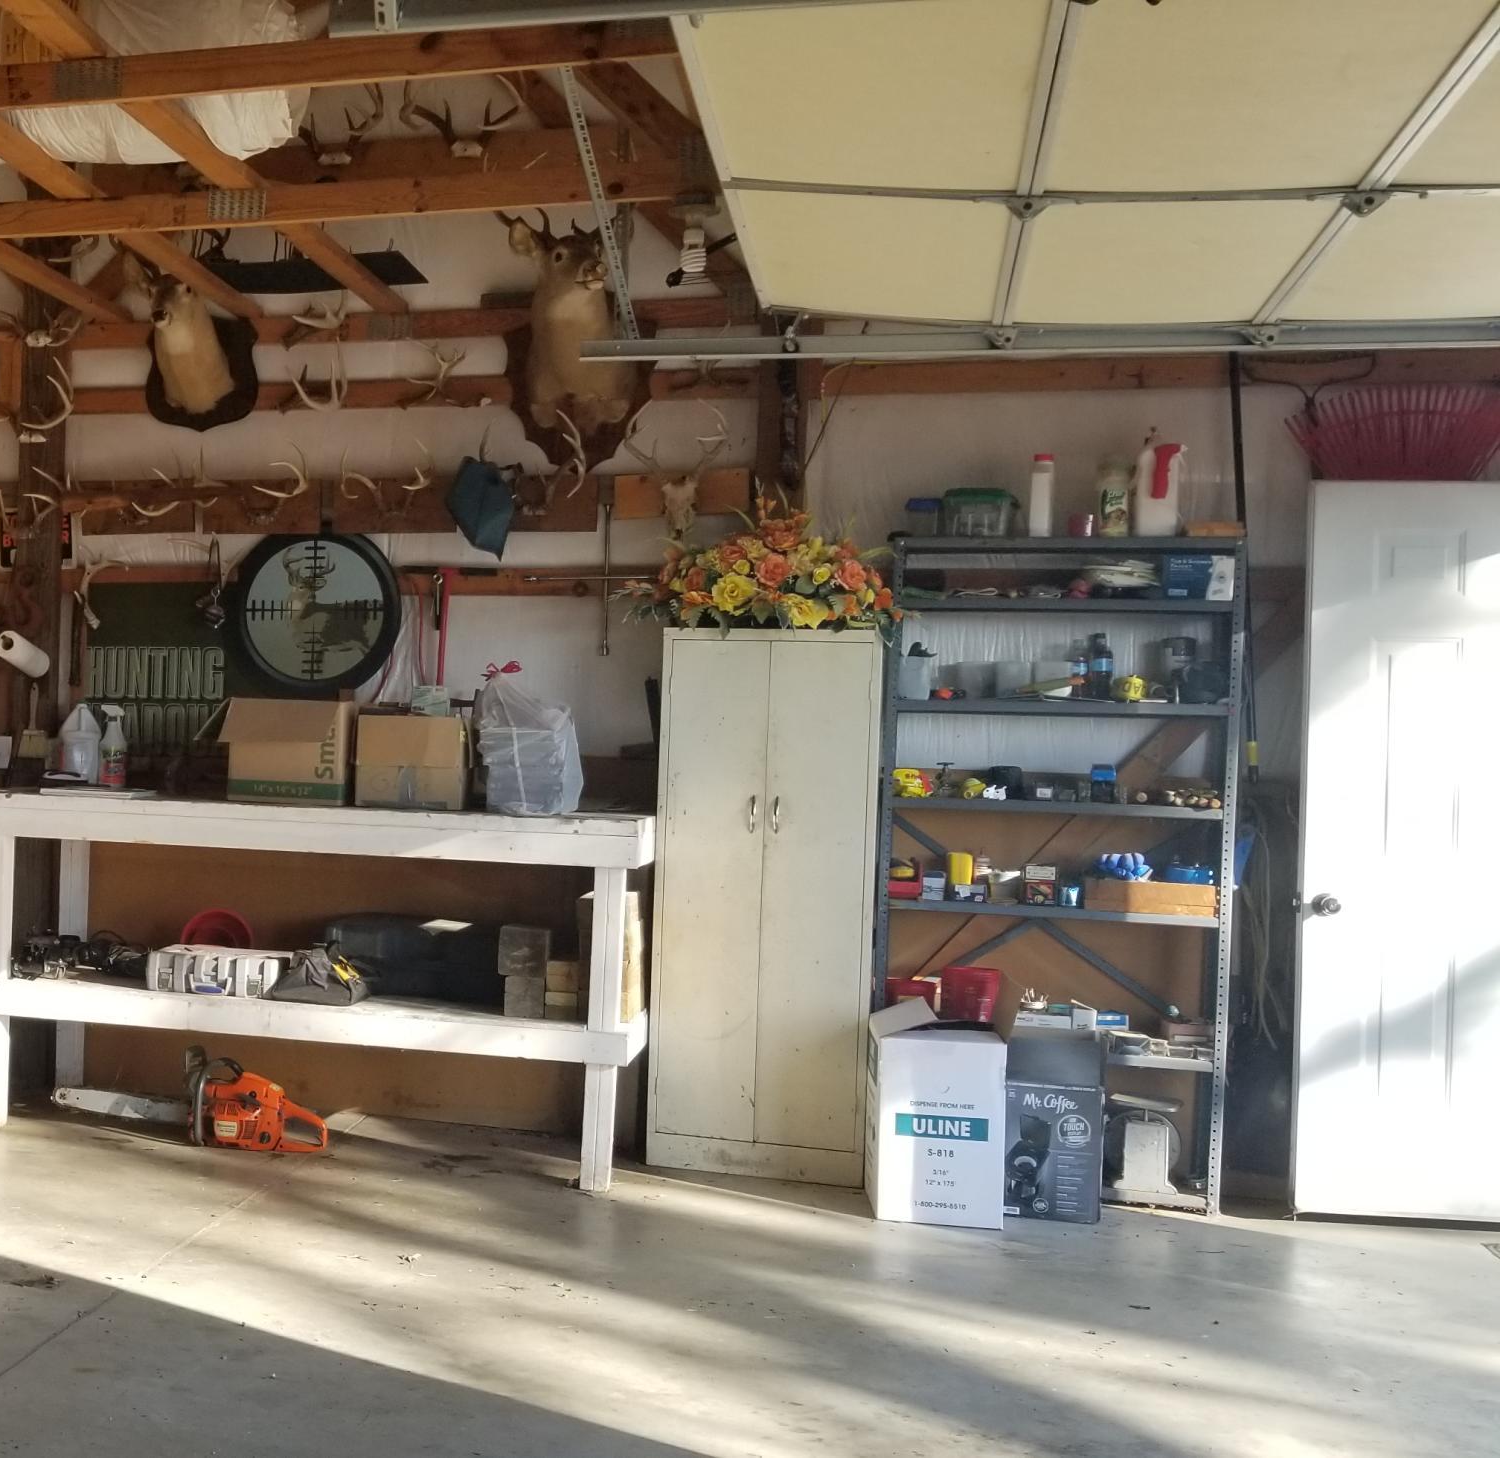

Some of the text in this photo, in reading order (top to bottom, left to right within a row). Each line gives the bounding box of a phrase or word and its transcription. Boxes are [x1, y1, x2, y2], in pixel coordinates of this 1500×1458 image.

[86, 646, 226, 699] HUNTING
[1043, 1093, 1079, 1114] Coffee
[912, 1117, 971, 1137] ULINE
[1063, 1122, 1085, 1132] TOUCH
[927, 1148, 955, 1158] S-818
